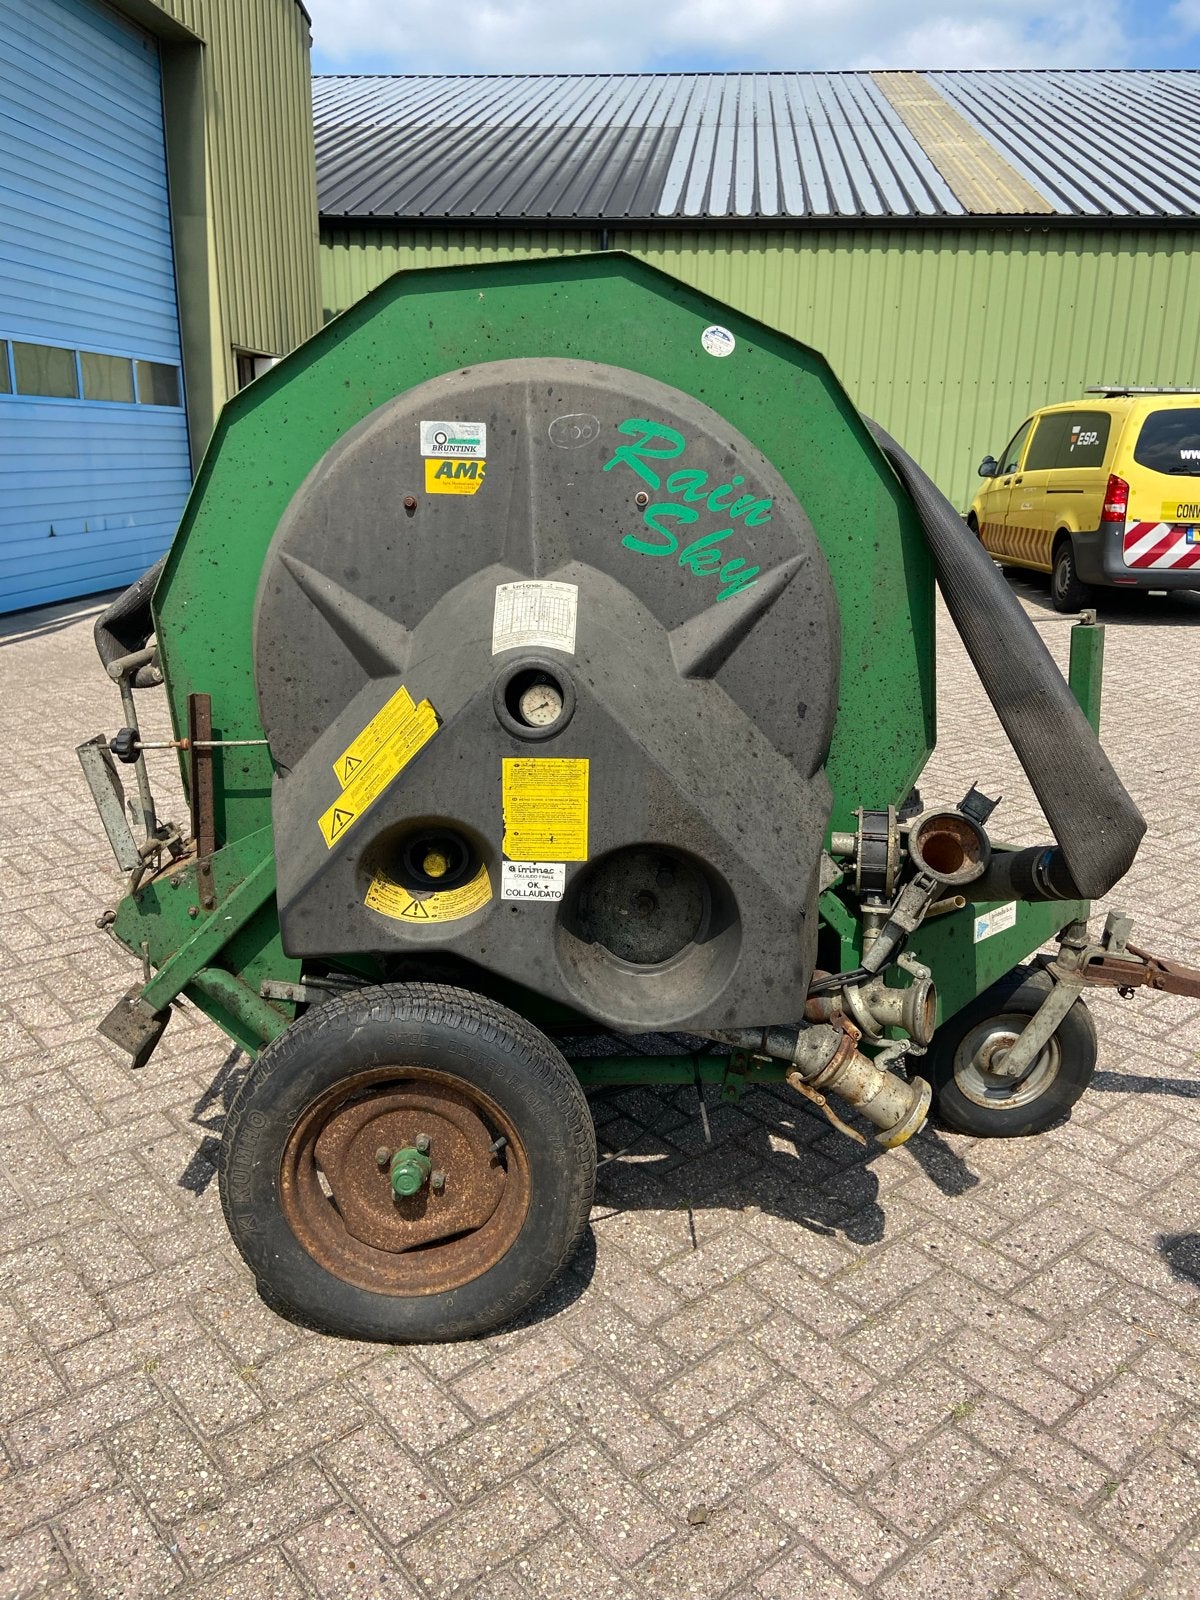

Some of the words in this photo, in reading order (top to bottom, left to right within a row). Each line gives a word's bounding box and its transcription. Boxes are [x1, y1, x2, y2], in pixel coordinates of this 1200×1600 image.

[432, 444, 477, 453] BRUNTINK
[602, 418, 773, 527] Rain
[621, 502, 760, 602] Sky
[505, 888, 562, 898] COLLAUDATO
[232, 1109, 267, 1204] KUMHO
